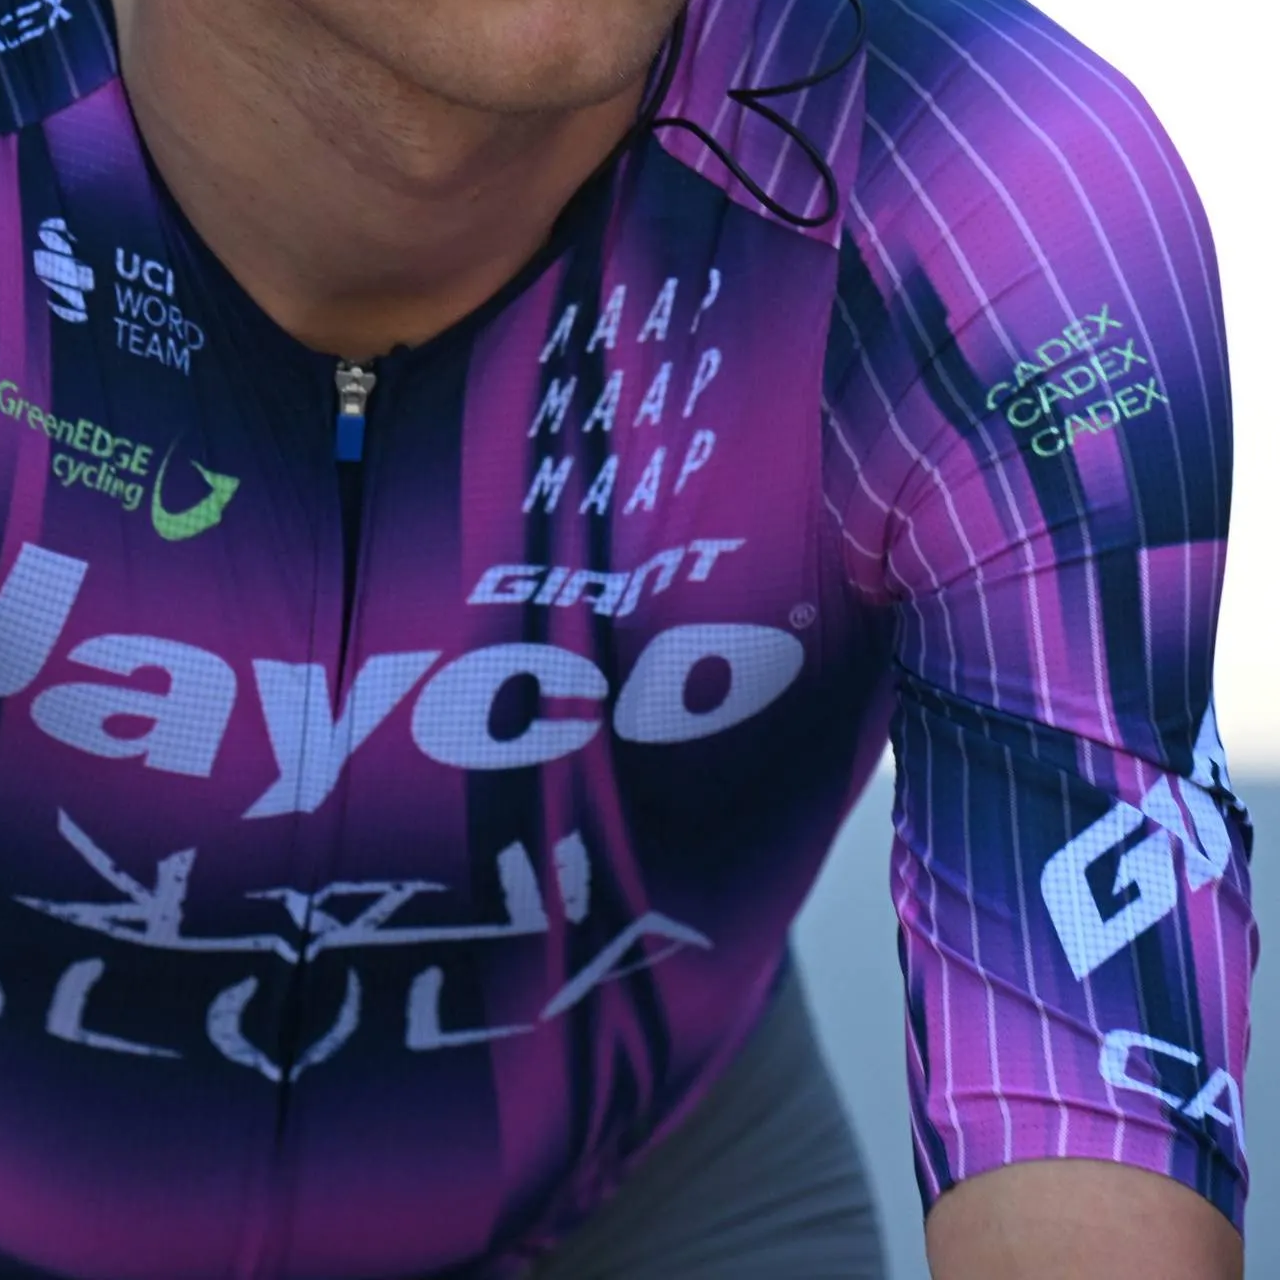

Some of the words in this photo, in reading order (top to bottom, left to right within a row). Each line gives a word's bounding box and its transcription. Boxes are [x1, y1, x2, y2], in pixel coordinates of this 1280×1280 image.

[115, 247, 175, 297] UCI
[113, 316, 190, 376] TEAM
[986, 302, 1124, 411] CADEX
[1006, 337, 1149, 429] CADEX
[526, 347, 723, 439] MAAP
[1031, 376, 1170, 458] CADEX
[51, 452, 145, 512] cycling
[521, 429, 717, 516] MAAP
[466, 538, 748, 617] GIANT
